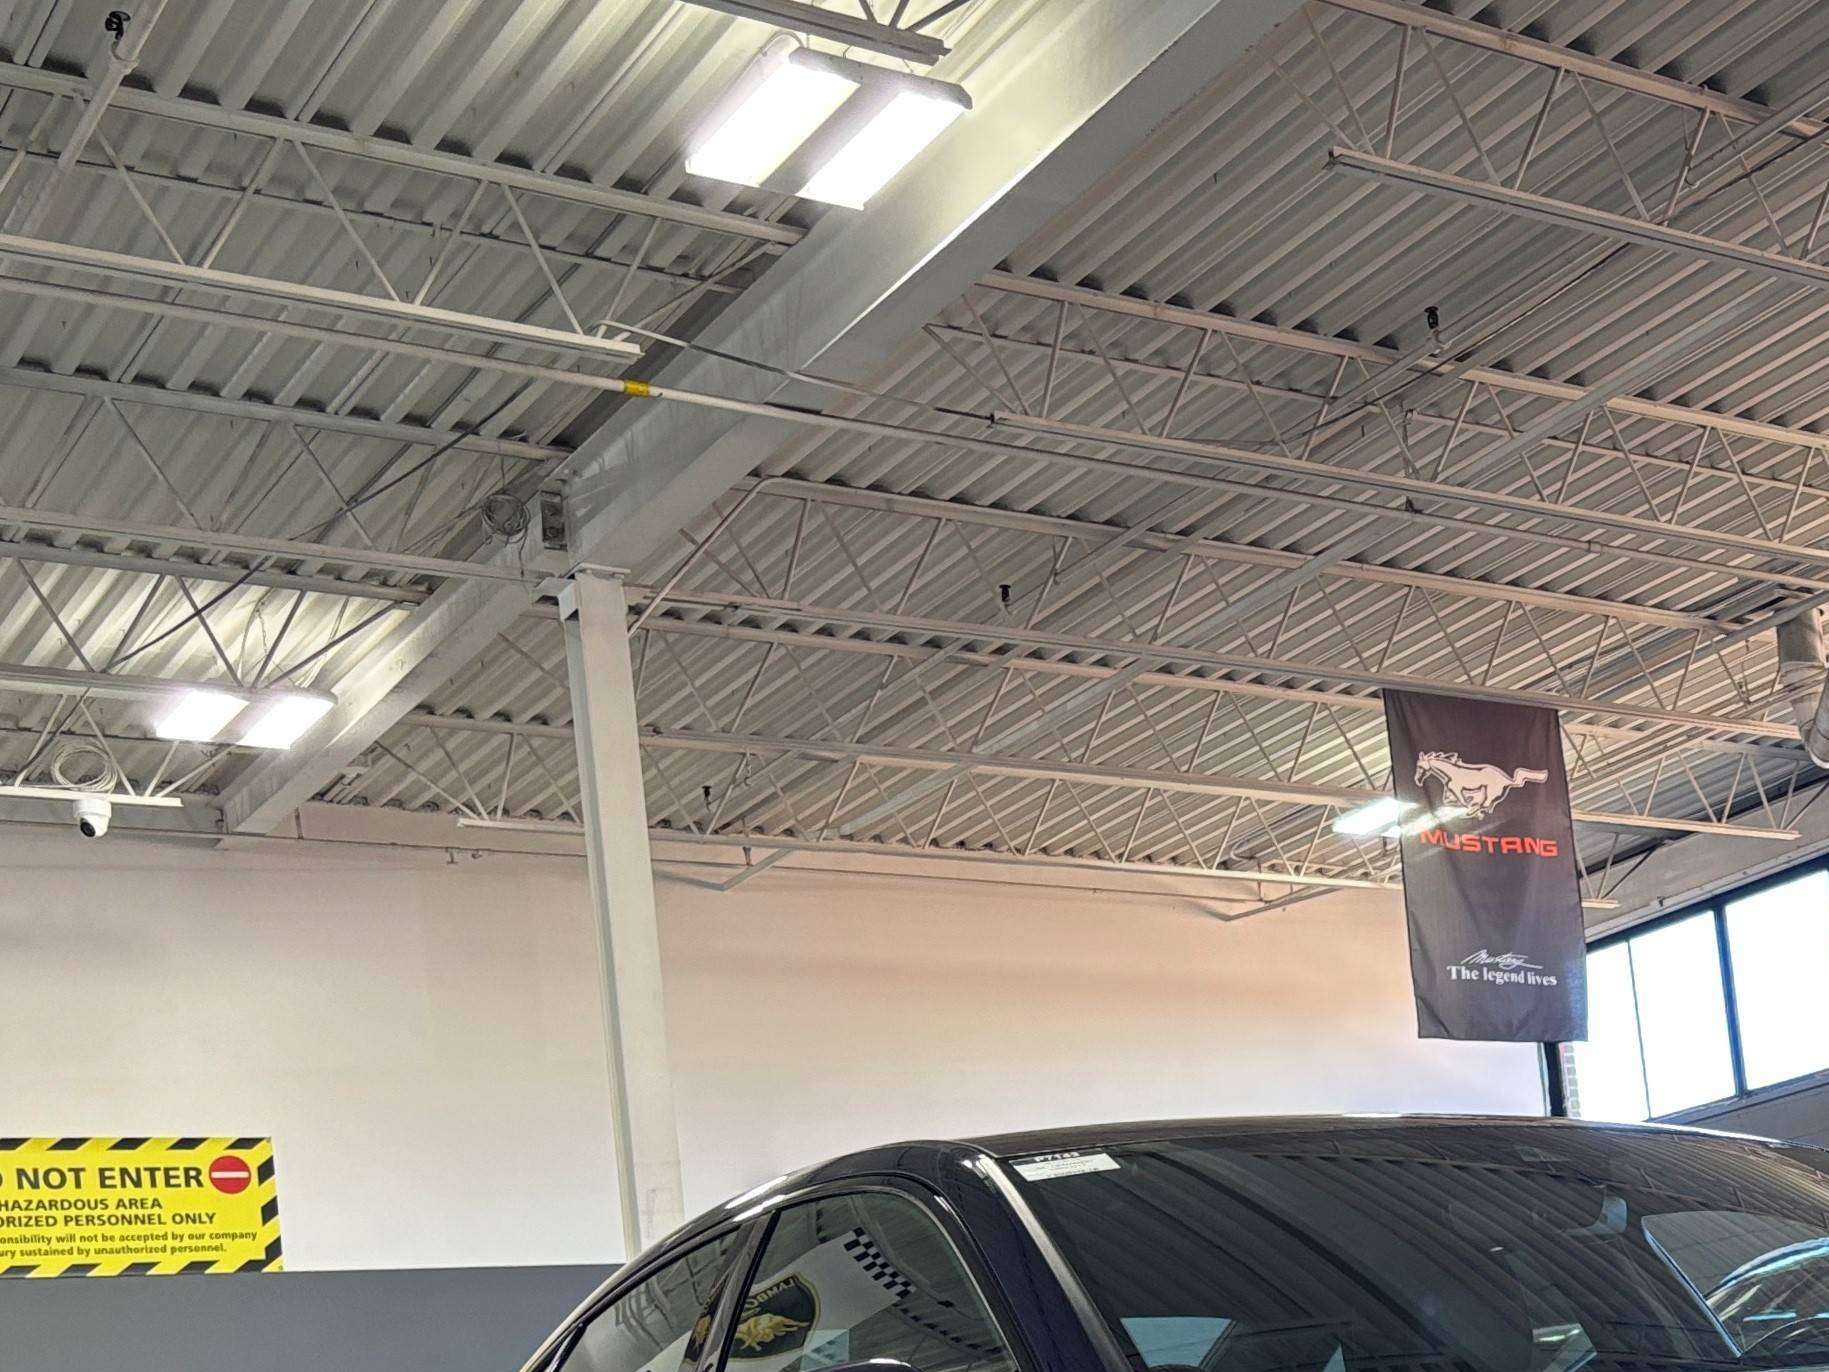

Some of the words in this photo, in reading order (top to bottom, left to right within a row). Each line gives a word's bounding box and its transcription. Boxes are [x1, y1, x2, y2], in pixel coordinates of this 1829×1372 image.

[1420, 829, 1558, 857] MUSTANG
[1446, 965, 1480, 981] The
[1483, 967, 1525, 986] legend
[1527, 971, 1557, 986] lives
[16, 1167, 86, 1190] NOT
[98, 1166, 204, 1189] ENTER
[0, 1198, 109, 1212] HAZARDOUS
[115, 1197, 163, 1211] AREA
[63, 1213, 167, 1227] PERSONNEL
[171, 1212, 216, 1225] ONLY
[55, 1233, 76, 1243] will
[80, 1233, 98, 1243] not
[101, 1232, 115, 1243] be
[119, 1231, 168, 1243] accepted
[171, 1231, 185, 1242] by
[188, 1232, 206, 1240] our
[209, 1231, 257, 1242] company
[19, 1246, 74, 1257] sustained
[76, 1246, 91, 1258] by
[94, 1244, 167, 1255] unauthorized
